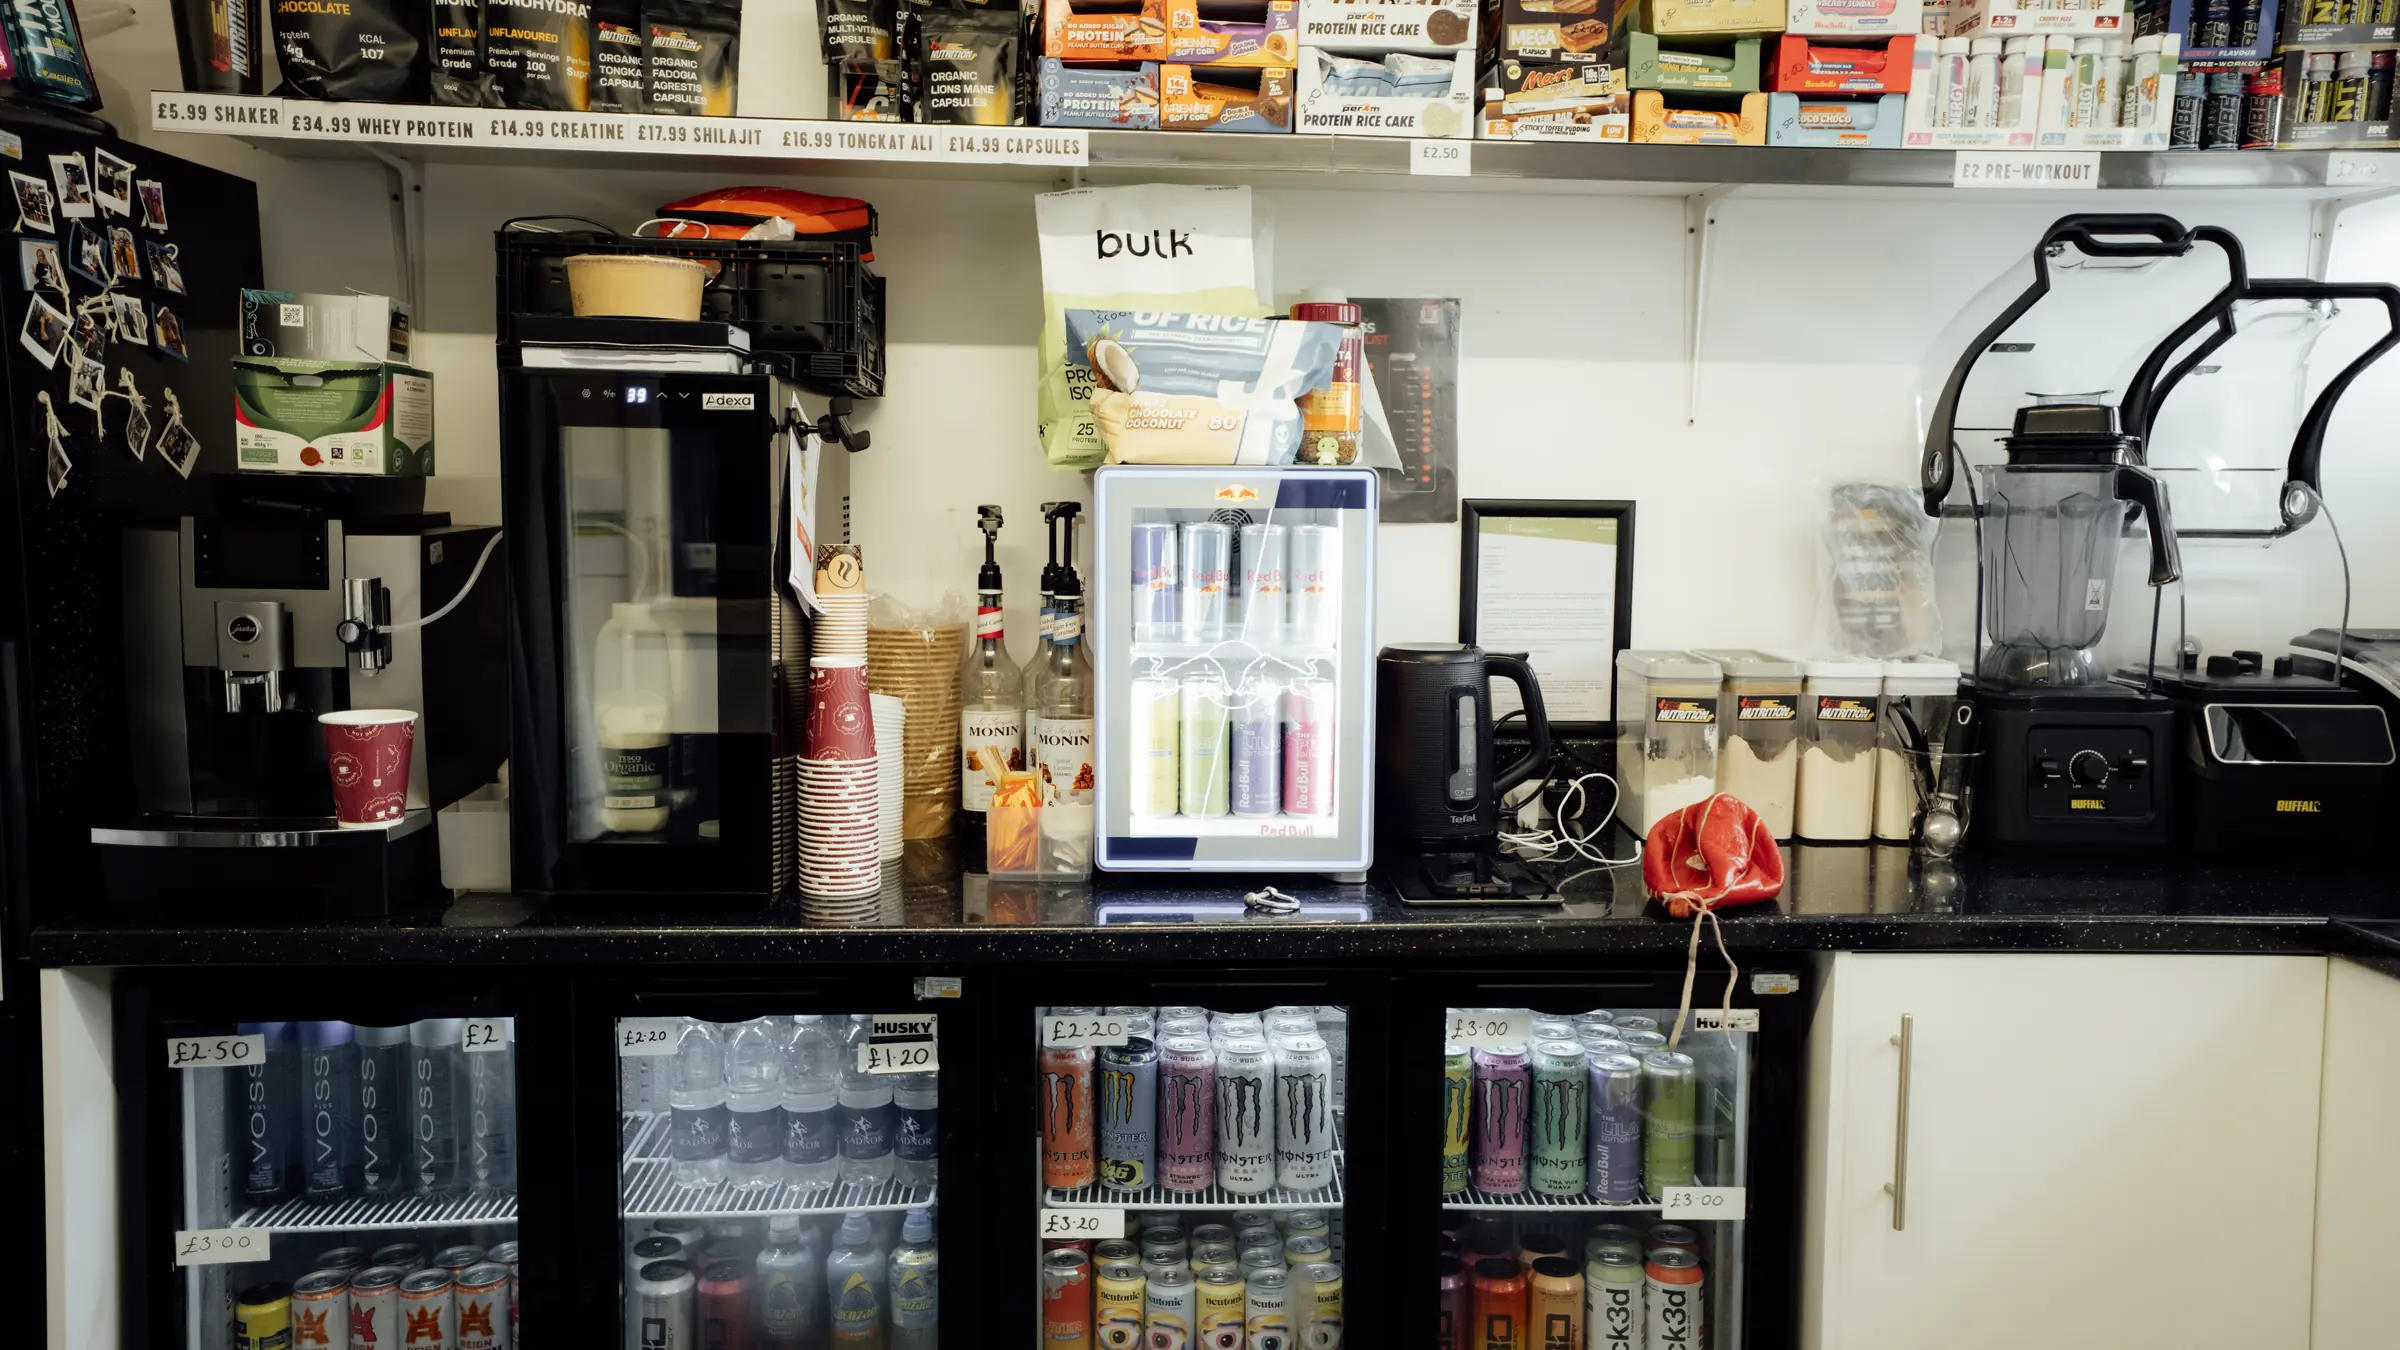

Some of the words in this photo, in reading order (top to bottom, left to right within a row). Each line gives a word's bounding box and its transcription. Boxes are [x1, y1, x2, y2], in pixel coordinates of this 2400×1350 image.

[827, 14, 868, 23] ORGANIC
[489, 27, 559, 43] UNFLAVOURED
[828, 25, 889, 37] MULTI-VITAMIN
[1307, 22, 1357, 35] PROTEIN
[1360, 23, 1386, 36] RICE
[1390, 23, 1420, 36] CAKE
[359, 33, 386, 45] KCAL
[652, 36, 697, 49] NUTRITION
[829, 36, 877, 45] CAPSULES
[1067, 30, 1124, 42] PROTEIN
[1511, 28, 1557, 46] MEGA
[440, 47, 475, 56] Premium
[1231, 45, 1259, 56] CARAMEL
[1232, 41, 1255, 50] GOLDEN
[360, 48, 385, 60] 107
[488, 47, 520, 56] Premium
[526, 50, 560, 62] Servings
[930, 49, 974, 60] NUTRITION
[442, 58, 472, 69] Grade
[488, 58, 518, 69] Grade
[526, 61, 546, 72] 100
[652, 56, 698, 69] ORGANIC
[652, 69, 698, 80] FADOGIA
[931, 71, 978, 82] ORGANIC
[1521, 67, 1574, 92] Mars
[653, 82, 702, 93] AGRESTIS
[931, 84, 961, 95] LIONS
[963, 84, 994, 94] MANE
[653, 93, 708, 105] CAPSULES
[931, 97, 987, 108] CAPSULES
[1063, 99, 1120, 111] PROTEIN
[157, 103, 207, 121] £5.99
[215, 106, 279, 125] SHAKER
[292, 115, 351, 133] £34.99
[357, 118, 401, 135] WHEY
[406, 120, 473, 139] PROTEIN
[1303, 114, 1353, 127] PROTEIN
[1356, 114, 1382, 127] RICE
[1385, 115, 1415, 128] CAKE
[490, 120, 544, 137] £14.99
[551, 122, 624, 140] CREATINE
[638, 124, 687, 142] £17.99
[693, 126, 762, 145] SHILAJIT
[1566, 125, 1590, 133] PUDDING
[783, 131, 833, 148] £16.99
[838, 133, 905, 150] TONGKAT
[911, 135, 933, 151] ALI
[949, 136, 1000, 153] £14.99
[1006, 138, 1080, 155] CAPSULES
[1423, 146, 1459, 159] £2.50
[1962, 163, 1980, 178] £2
[1985, 163, 2091, 180] PRE-WORKOUT
[1097, 229, 1193, 260] bulk
[1133, 311, 1183, 328] OF
[1186, 313, 1267, 333] RICE
[627, 388, 648, 403] 39
[705, 395, 752, 406] Adexa
[1128, 409, 1198, 419] CHOCOLATE
[1076, 423, 1095, 436] 25
[1125, 419, 1186, 430] COCONUT
[1208, 415, 1238, 431] 80
[1247, 569, 1272, 582] Red
[1656, 708, 1709, 722] NUTRITION
[1739, 705, 1791, 719] NUTRITION
[1819, 706, 1870, 720] NUTRITION
[969, 726, 1018, 737] MONIN
[1039, 734, 1091, 746] MONIN
[619, 755, 641, 763] TESCO
[604, 760, 656, 775] Organic
[1239, 760, 1250, 783] Bull
[1296, 761, 1309, 783] Bull
[1239, 784, 1250, 808] Red
[1296, 785, 1308, 809] Red
[1450, 813, 1477, 824] Tefal
[873, 1021, 932, 1034] HUSKY
[465, 1024, 499, 1047] £2
[1239, 1055, 1263, 1063] SUGAR
[1285, 1053, 1303, 1061] ZERO
[314, 1055, 332, 1163] VOSS
[361, 1057, 379, 1170] VOSS
[417, 1057, 435, 1170] VOSS
[472, 1055, 488, 1167] VOSS
[679, 1134, 722, 1148] RADNOR
[844, 1135, 884, 1145] RADNOR
[1218, 1152, 1273, 1167] MONSTER
[1597, 1144, 1609, 1168] Bull
[1597, 1170, 1609, 1194] Red
[1100, 1290, 1140, 1302] neutonic
[460, 1339, 493, 1349] REIGN
